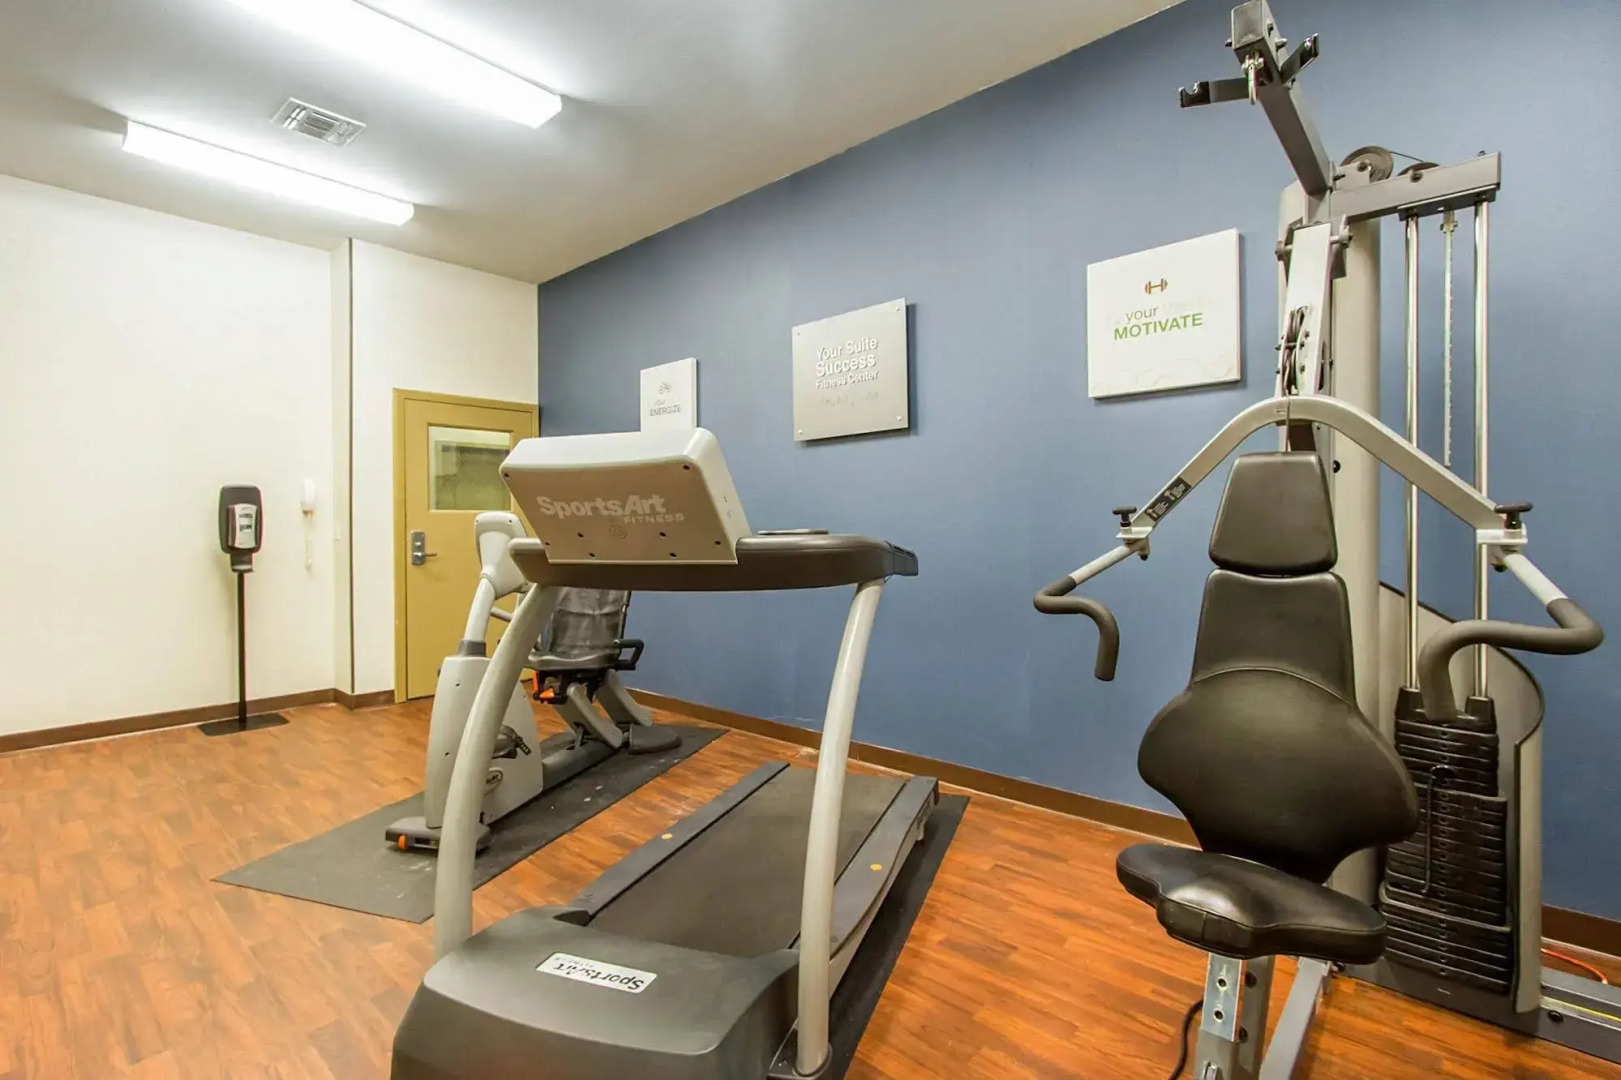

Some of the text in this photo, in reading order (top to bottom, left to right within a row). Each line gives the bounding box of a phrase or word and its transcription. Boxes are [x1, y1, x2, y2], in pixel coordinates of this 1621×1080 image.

[1126, 306, 1159, 324] your
[1114, 312, 1203, 341] MOTIVATE
[816, 337, 879, 361] Your Suite
[816, 353, 877, 378] Success
[816, 370, 879, 389] Fitness Center
[649, 403, 681, 417] ENERGIZE
[536, 494, 667, 519] SportsArt
[623, 512, 685, 525] FITNESS
